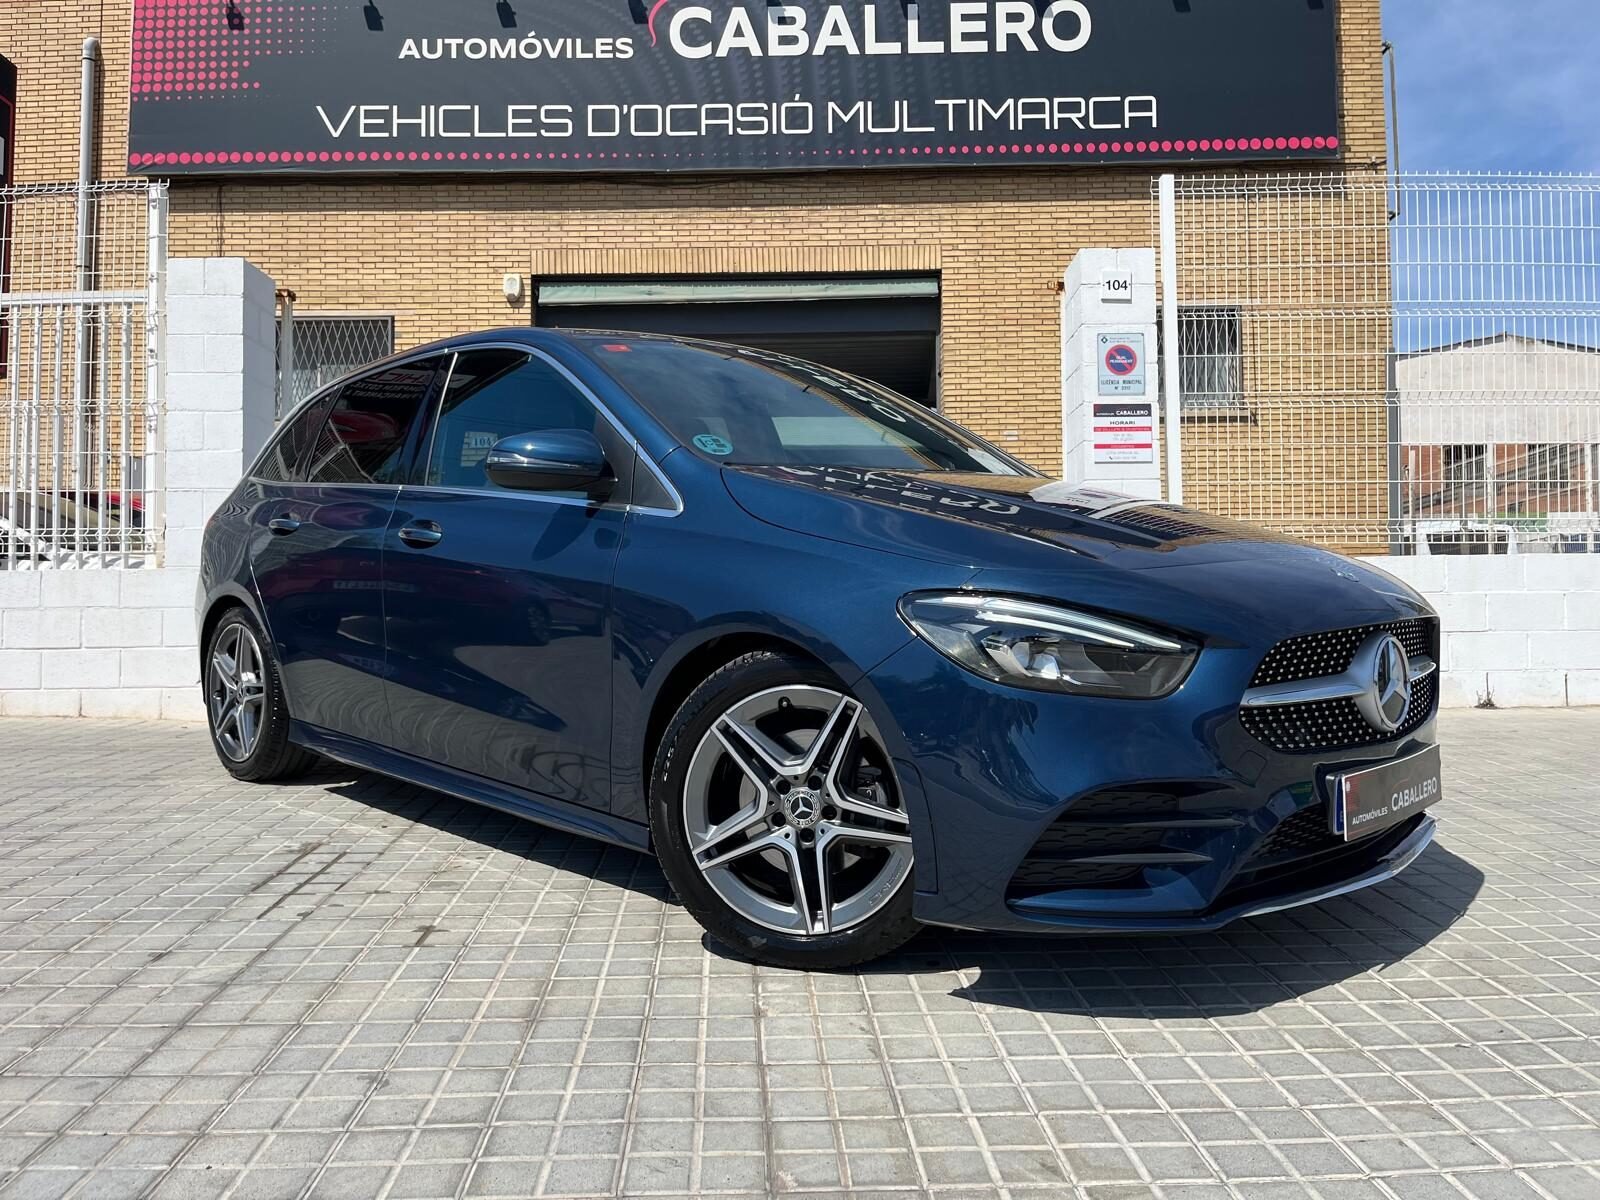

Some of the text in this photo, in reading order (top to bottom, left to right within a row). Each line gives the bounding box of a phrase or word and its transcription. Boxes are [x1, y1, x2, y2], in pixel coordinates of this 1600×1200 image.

[398, 0, 1092, 60] AUTOMÓVILES CABALLERO
[316, 94, 1157, 138] VEHICLES D'OCASIÓ MULTIMARCA
[1105, 279, 1128, 290] 104
[1351, 806, 1388, 825] AUTOMÓVILES
[1391, 776, 1438, 811] CABALLERO
